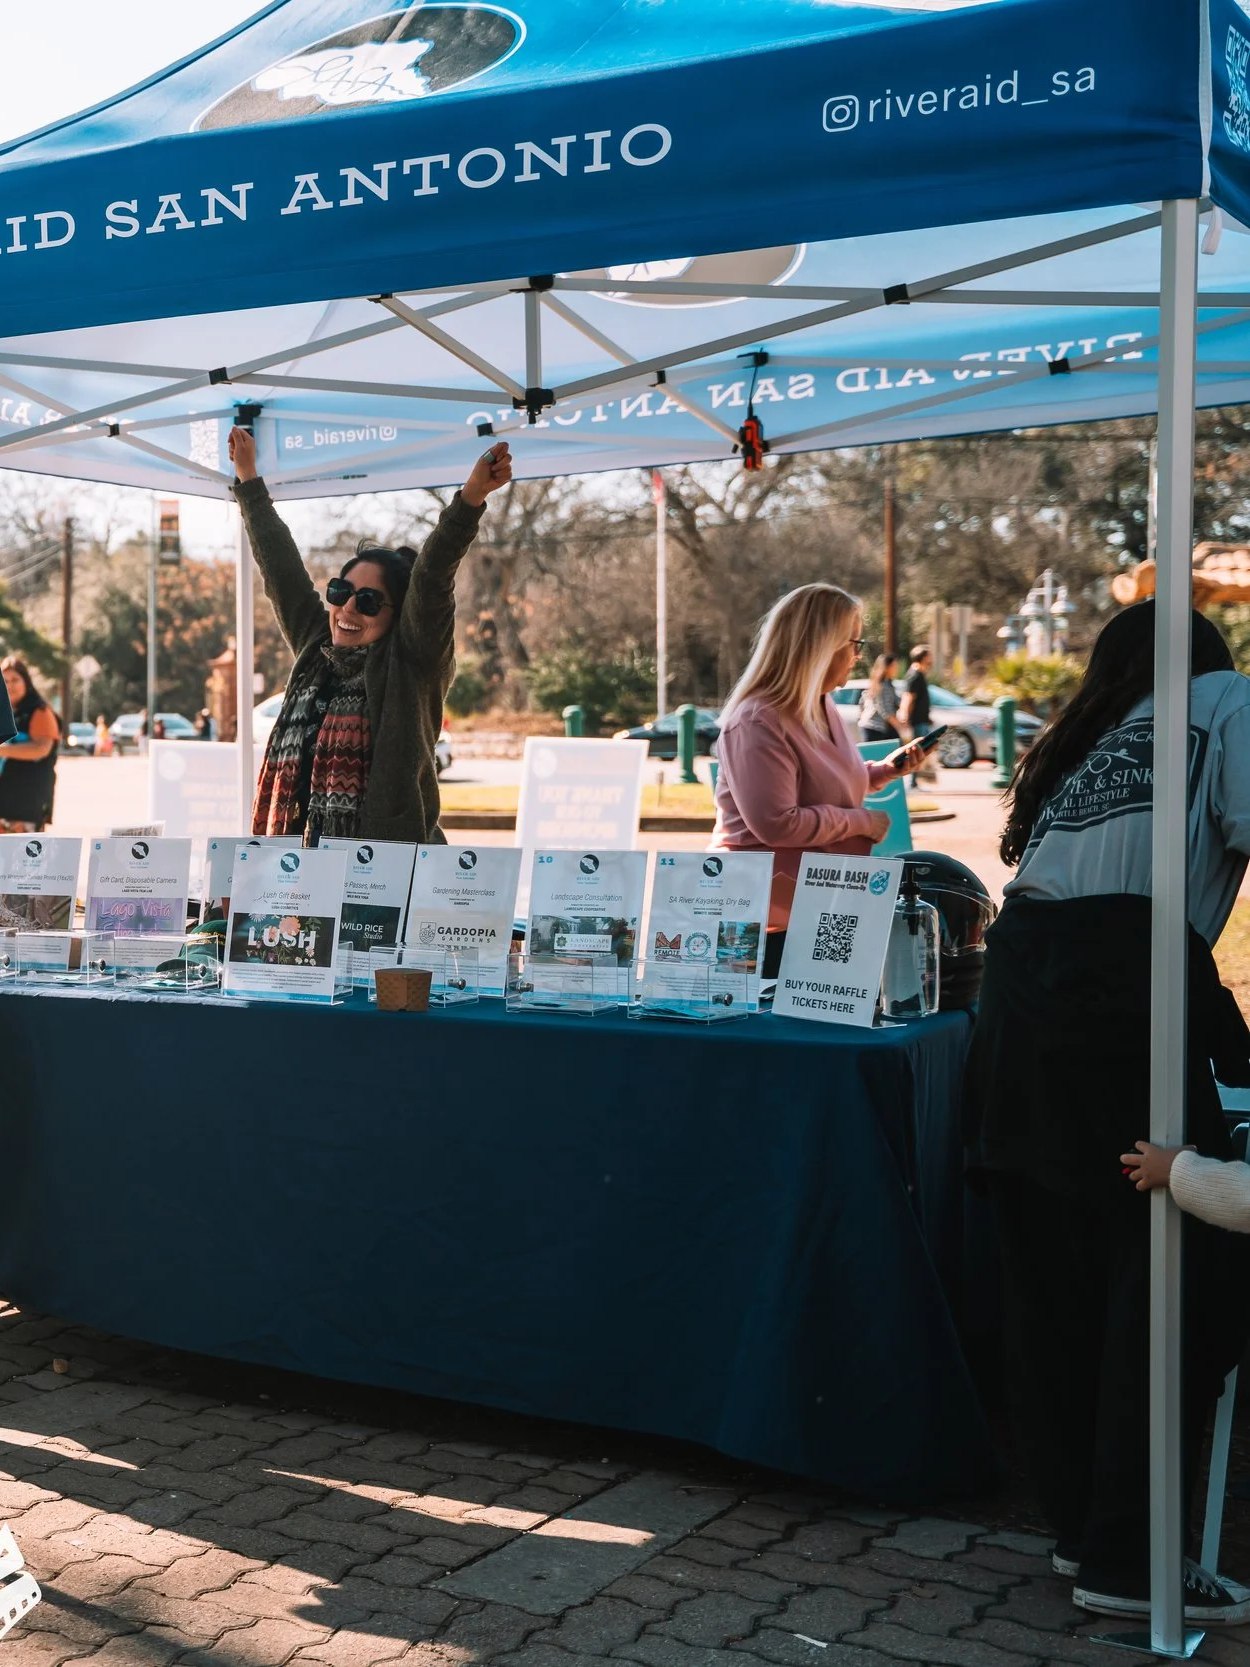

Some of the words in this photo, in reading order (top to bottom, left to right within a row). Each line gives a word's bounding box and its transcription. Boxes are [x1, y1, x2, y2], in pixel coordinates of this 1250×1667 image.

[867, 66, 1097, 123] riveraid_sa
[105, 182, 254, 241] SAN
[281, 123, 673, 215] ANTONIO
[1117, 731, 1154, 744] TACK
[1111, 768, 1154, 787] SINK
[1078, 788, 1130, 807] LIFESTYLE
[240, 853, 248, 861] 2
[538, 855, 553, 863] 10
[111, 876, 124, 884] Card,
[125, 877, 155, 886] Disposable
[806, 867, 841, 881] BASURA
[844, 870, 869, 884] BASH
[349, 881, 369, 890] Passes,
[825, 882, 846, 890] Waterway
[846, 884, 867, 892] Clean-Up
[432, 886, 461, 896] Gardening
[462, 888, 496, 897] Masterclass
[551, 893, 583, 901] Landscape
[584, 893, 623, 901] Consultation
[678, 896, 694, 904] River
[695, 897, 725, 907] Kayaking,
[725, 898, 736, 907] Dry
[737, 899, 751, 907] Bag
[102, 899, 135, 920] Lago
[141, 899, 171, 918] Vista
[341, 922, 363, 931] WILD
[365, 924, 384, 932] RICE
[438, 926, 496, 937] GARDOPIA
[247, 926, 316, 949] LUSH
[363, 932, 383, 940] Studio
[785, 979, 804, 990] BUY
[805, 981, 832, 993] YOUR
[833, 985, 868, 998] RAFFLE
[791, 996, 828, 1011] TICKETS
[830, 1002, 855, 1014] HERE
